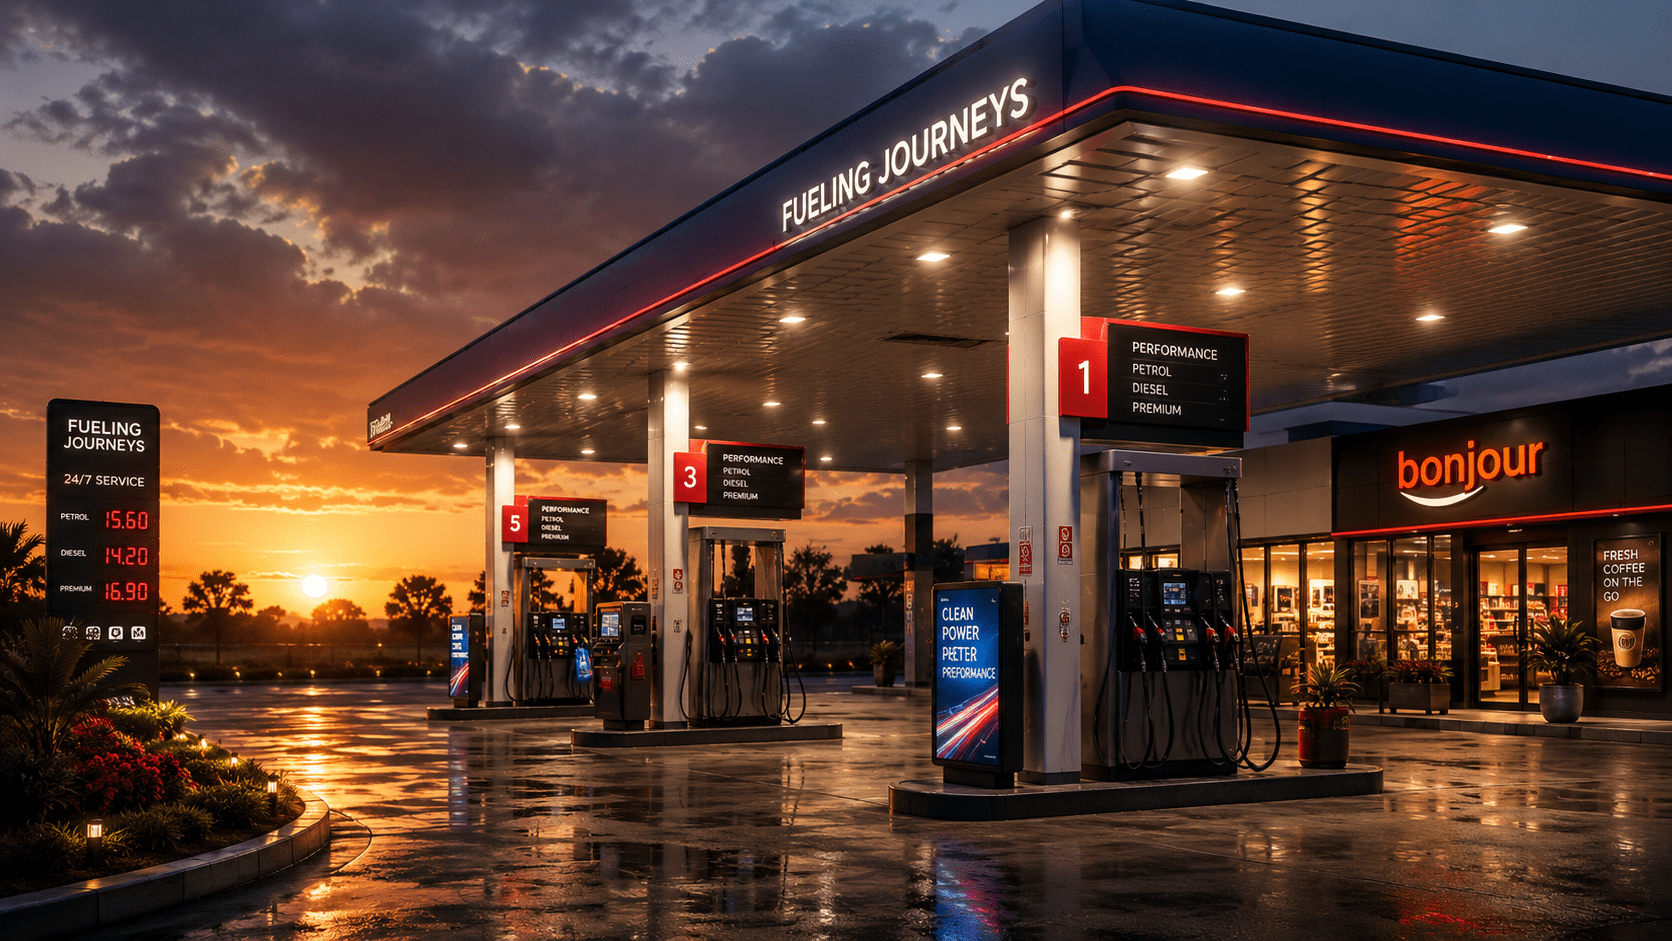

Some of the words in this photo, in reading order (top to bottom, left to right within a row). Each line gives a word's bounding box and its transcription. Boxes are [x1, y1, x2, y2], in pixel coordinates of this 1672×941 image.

[782, 160, 871, 233] FUELING
[878, 77, 1030, 185] JOURNEYS
[1132, 341, 1218, 361] PERFORMANCE
[1078, 360, 1090, 395] 1
[1132, 363, 1172, 377] PETROL
[1132, 382, 1169, 396] DIESEL
[1132, 401, 1182, 416] PREMIUM
[67, 418, 142, 437] FUELING
[63, 435, 145, 453] JOURNEYS
[722, 453, 784, 466] PERFORMANCE
[1398, 440, 1544, 491] bonjour
[683, 465, 697, 488] 3
[722, 466, 752, 477] PETROL
[64, 473, 92, 486] 24/7
[95, 475, 145, 487] SERVICE
[722, 479, 749, 488] DIESEL
[722, 491, 759, 501] PREMIUM
[60, 512, 90, 521] PETROL
[105, 510, 149, 530] 15.60
[509, 514, 521, 532] 5
[60, 549, 87, 557] DIESEL
[105, 546, 148, 566] 14.20
[1603, 549, 1639, 561] FRESH
[1603, 562, 1646, 575] COFFEE
[1603, 577, 1620, 588] ON
[1622, 576, 1643, 587] THE
[59, 585, 92, 593] PREMIUM
[105, 582, 148, 601] 16.90
[1603, 591, 1620, 602] GO
[942, 606, 974, 622] CLEAN
[942, 625, 980, 641] POWER
